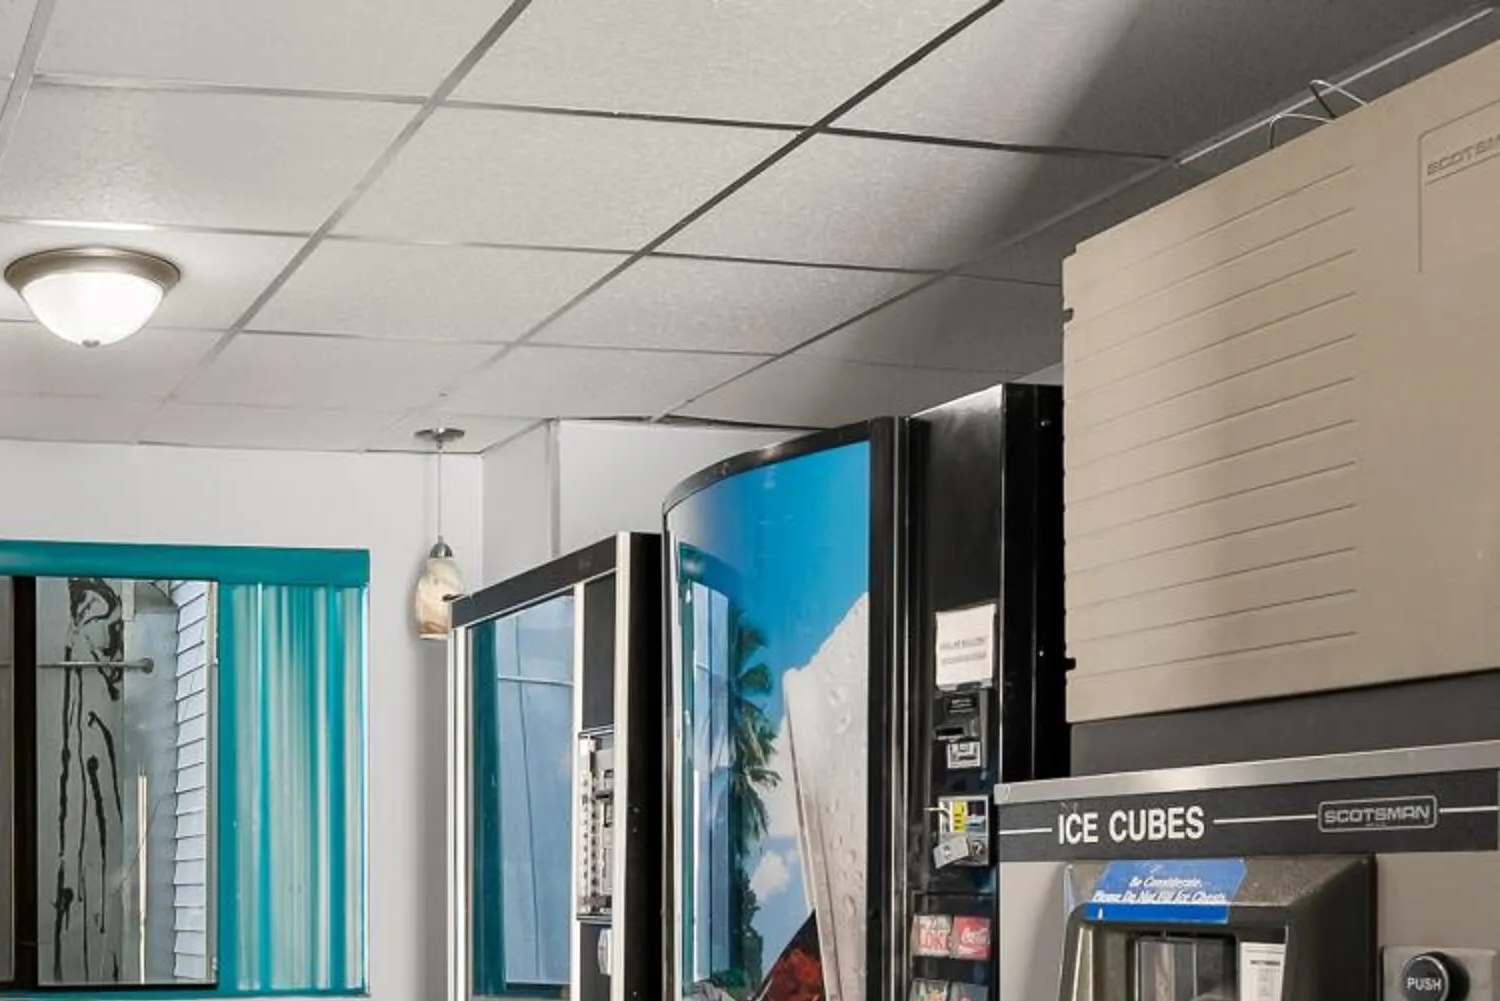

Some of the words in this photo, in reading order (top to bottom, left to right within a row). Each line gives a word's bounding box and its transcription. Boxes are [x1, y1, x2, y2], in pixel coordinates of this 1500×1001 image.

[1324, 805, 1430, 823] SCOTSMAN
[1058, 812, 1099, 845] ICE
[1108, 805, 1205, 843] CUBES
[1406, 976, 1442, 991] PUSH
